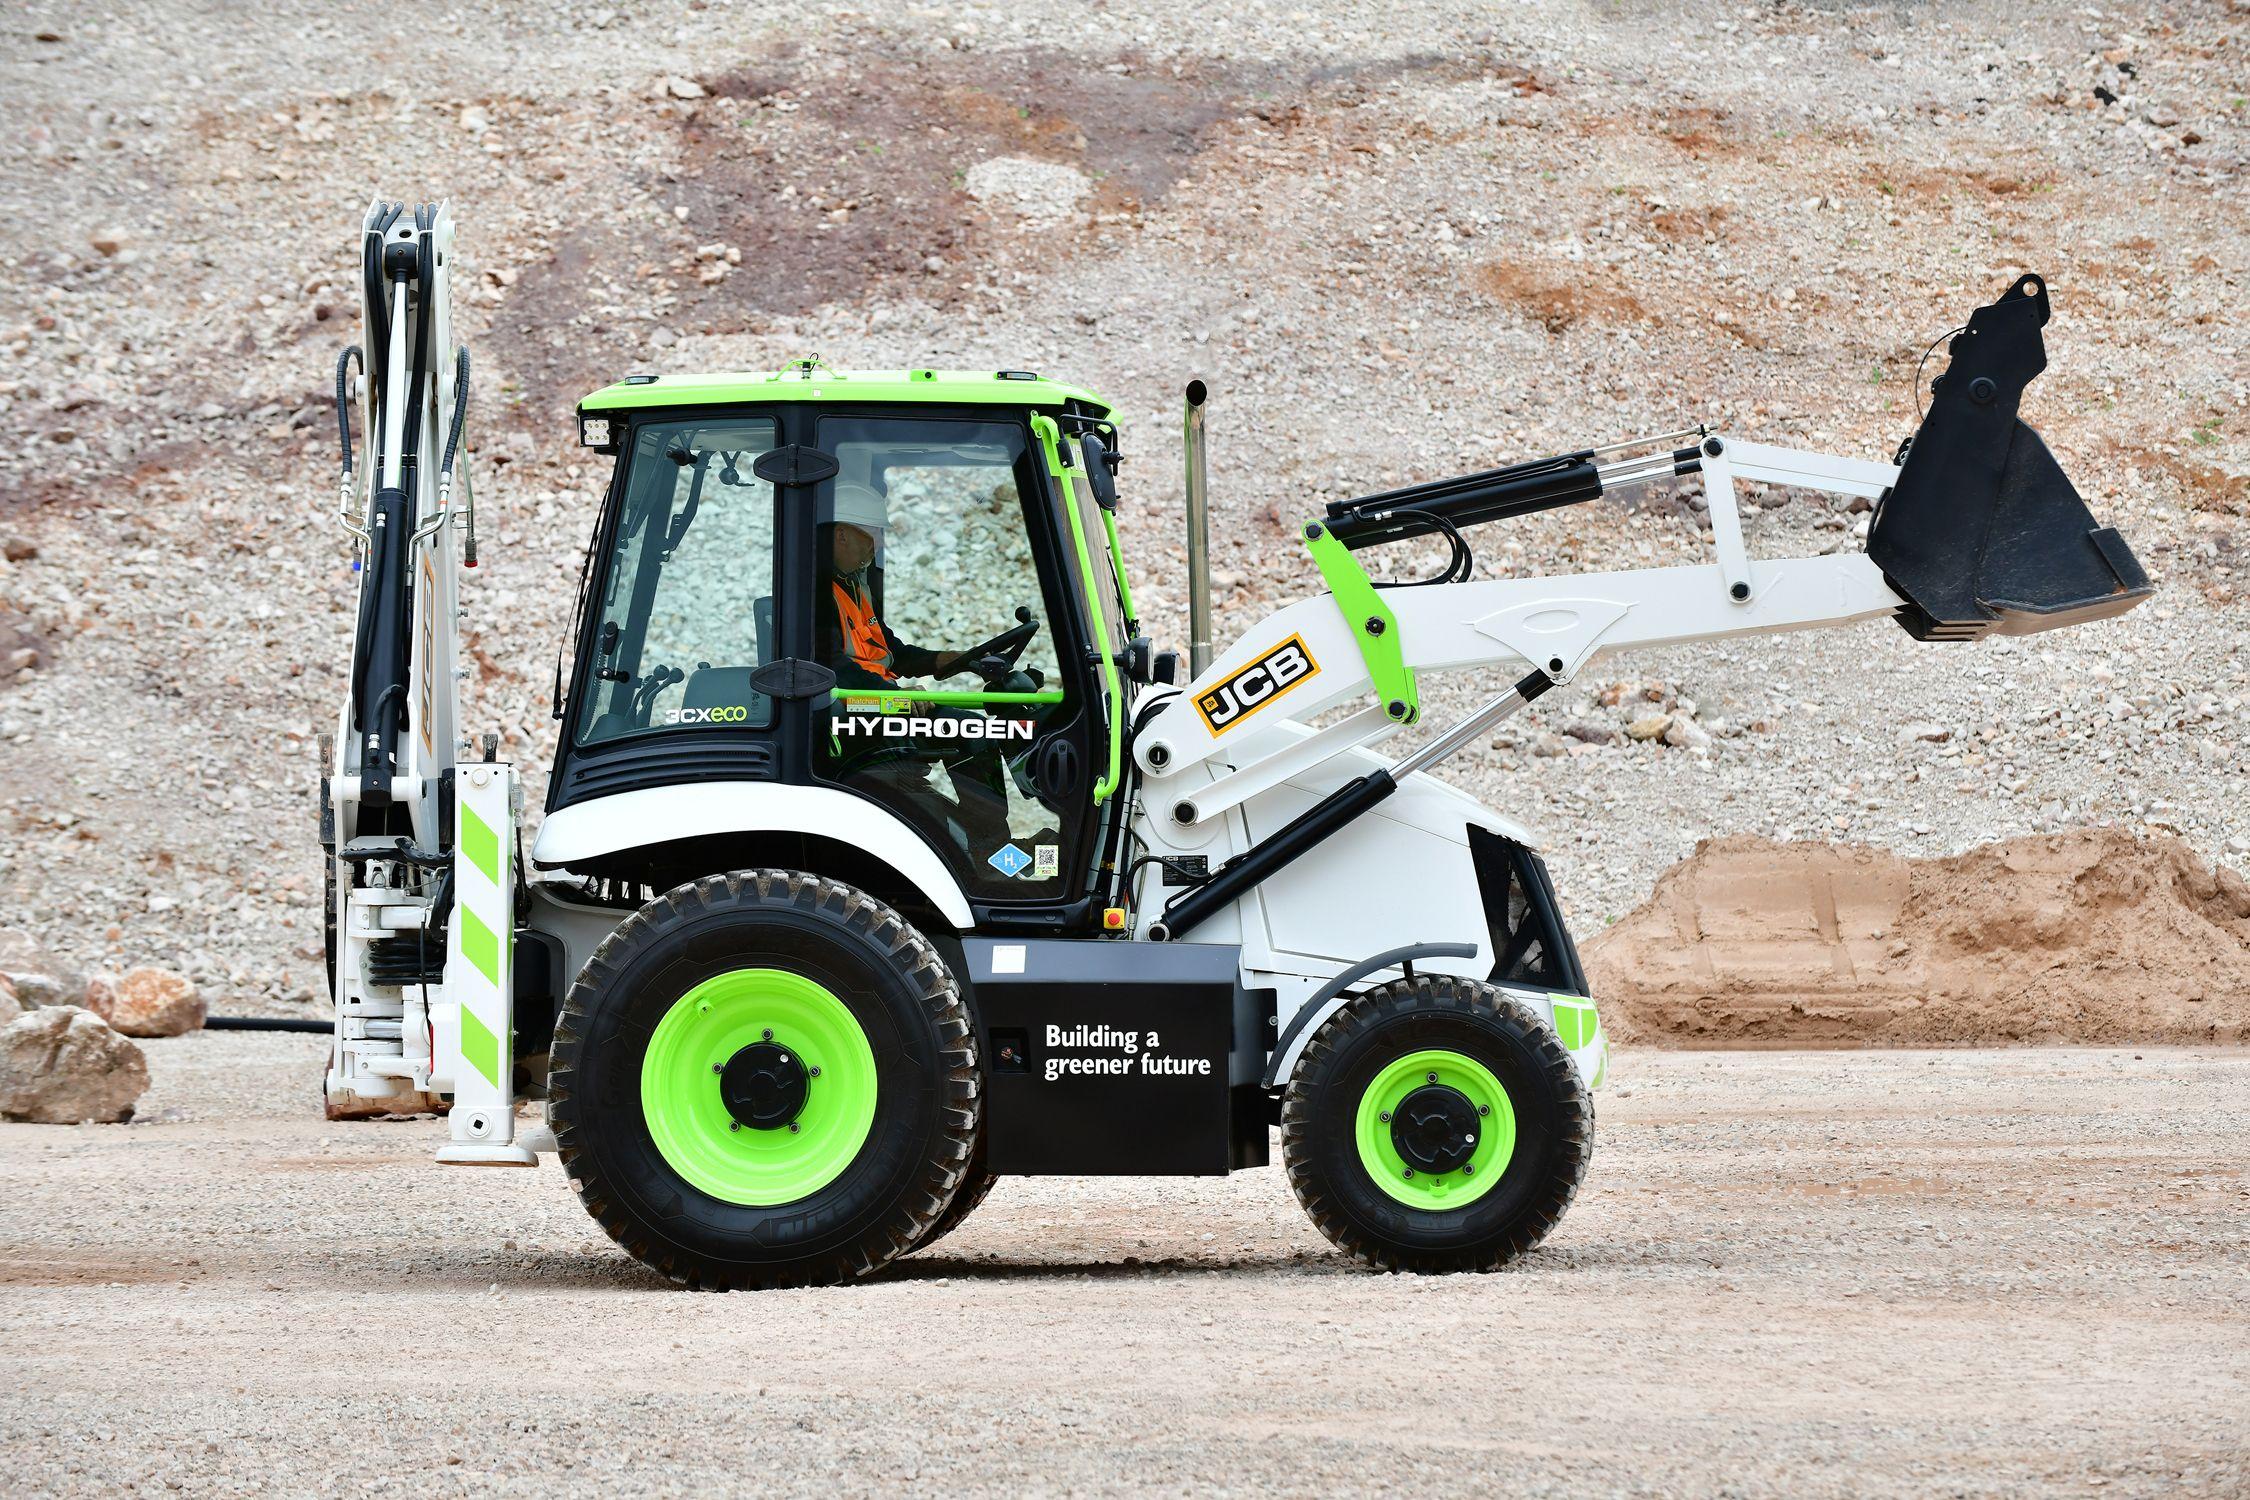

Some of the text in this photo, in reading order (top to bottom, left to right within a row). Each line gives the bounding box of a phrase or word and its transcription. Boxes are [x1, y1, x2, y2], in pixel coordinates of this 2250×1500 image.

[1210, 646, 1308, 725] JCB
[832, 716, 1034, 740] HYDROGEN
[1046, 1024, 1160, 1054] Building a
[1044, 1052, 1211, 1081] greener future
